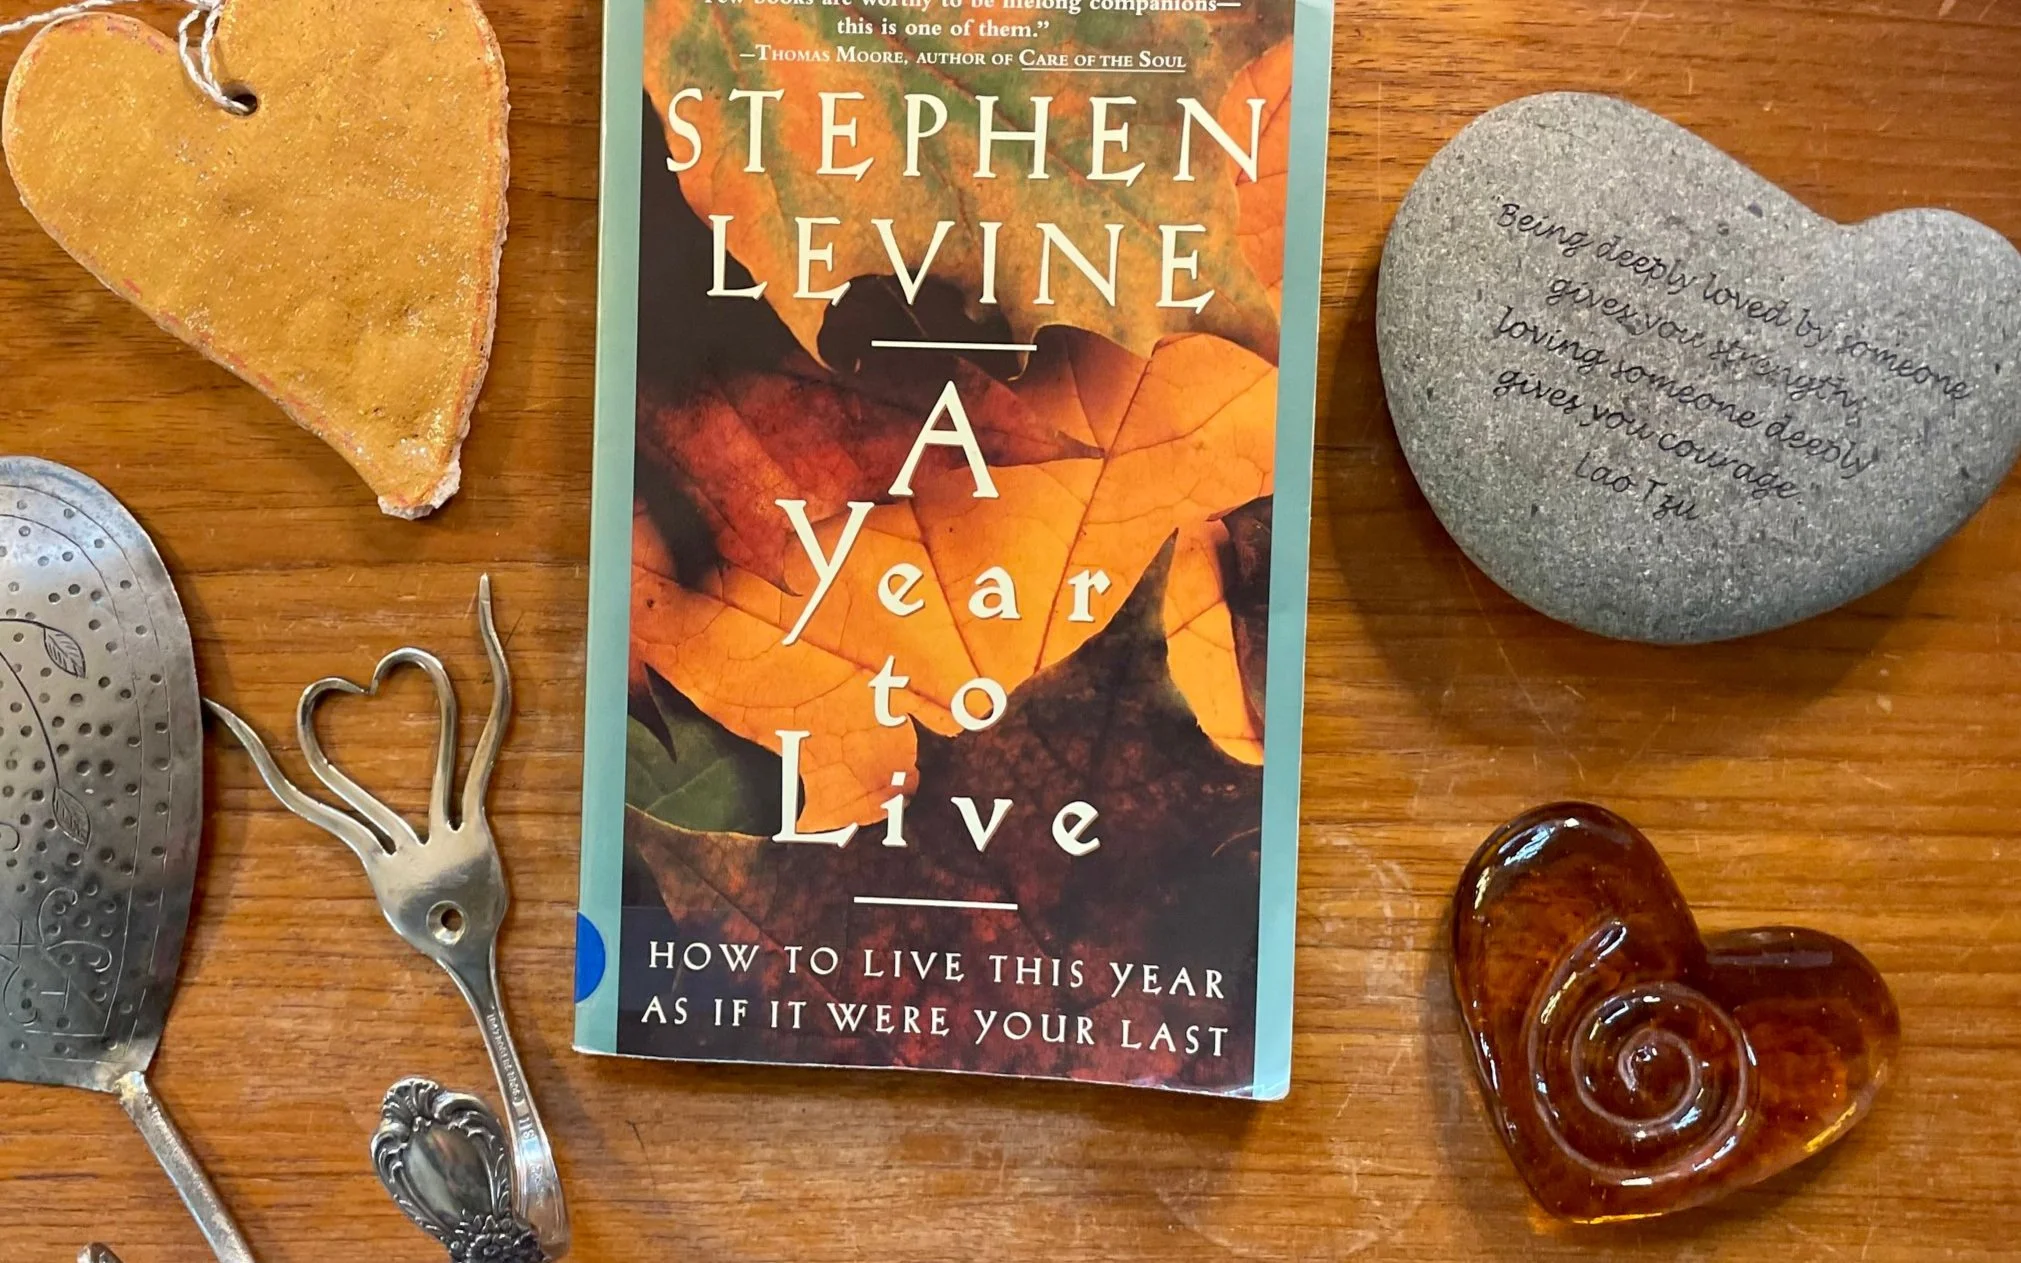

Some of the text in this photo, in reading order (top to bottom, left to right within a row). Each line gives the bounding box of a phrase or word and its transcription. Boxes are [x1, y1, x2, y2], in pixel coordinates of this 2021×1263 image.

[836, 45, 908, 65] MOORE,
[916, 52, 986, 65] AUTHOR
[991, 53, 1013, 66] OF
[1018, 48, 1069, 67] CARE
[1073, 54, 1096, 68] OF
[1099, 54, 1133, 68] THE
[1139, 50, 1188, 68] SOUL
[837, 16, 873, 35] this
[881, 17, 897, 35] is
[904, 23, 942, 37] one
[950, 18, 976, 37] of
[666, 87, 1266, 187] STEPHEN
[706, 214, 1215, 314] LEVINE
[1546, 278, 1638, 325] gives
[1630, 314, 1707, 349] you
[1597, 235, 1697, 295] deeply
[1703, 272, 1792, 326] loved
[1796, 308, 1833, 347] by
[1838, 335, 1971, 400] someone
[1493, 370, 1583, 414] gives
[1580, 404, 1656, 441] you
[1497, 306, 1872, 479] loving someone deeply
[888, 380, 999, 498] A
[1574, 450, 1700, 521] Lao Tzu
[774, 498, 1111, 646] Year
[868, 655, 1008, 731] to
[772, 729, 1101, 856] Live
[649, 941, 1224, 999] HOW TO LIVE THIS YEAR
[641, 995, 1229, 1058] AS IF IT WERE YOUR LAST
